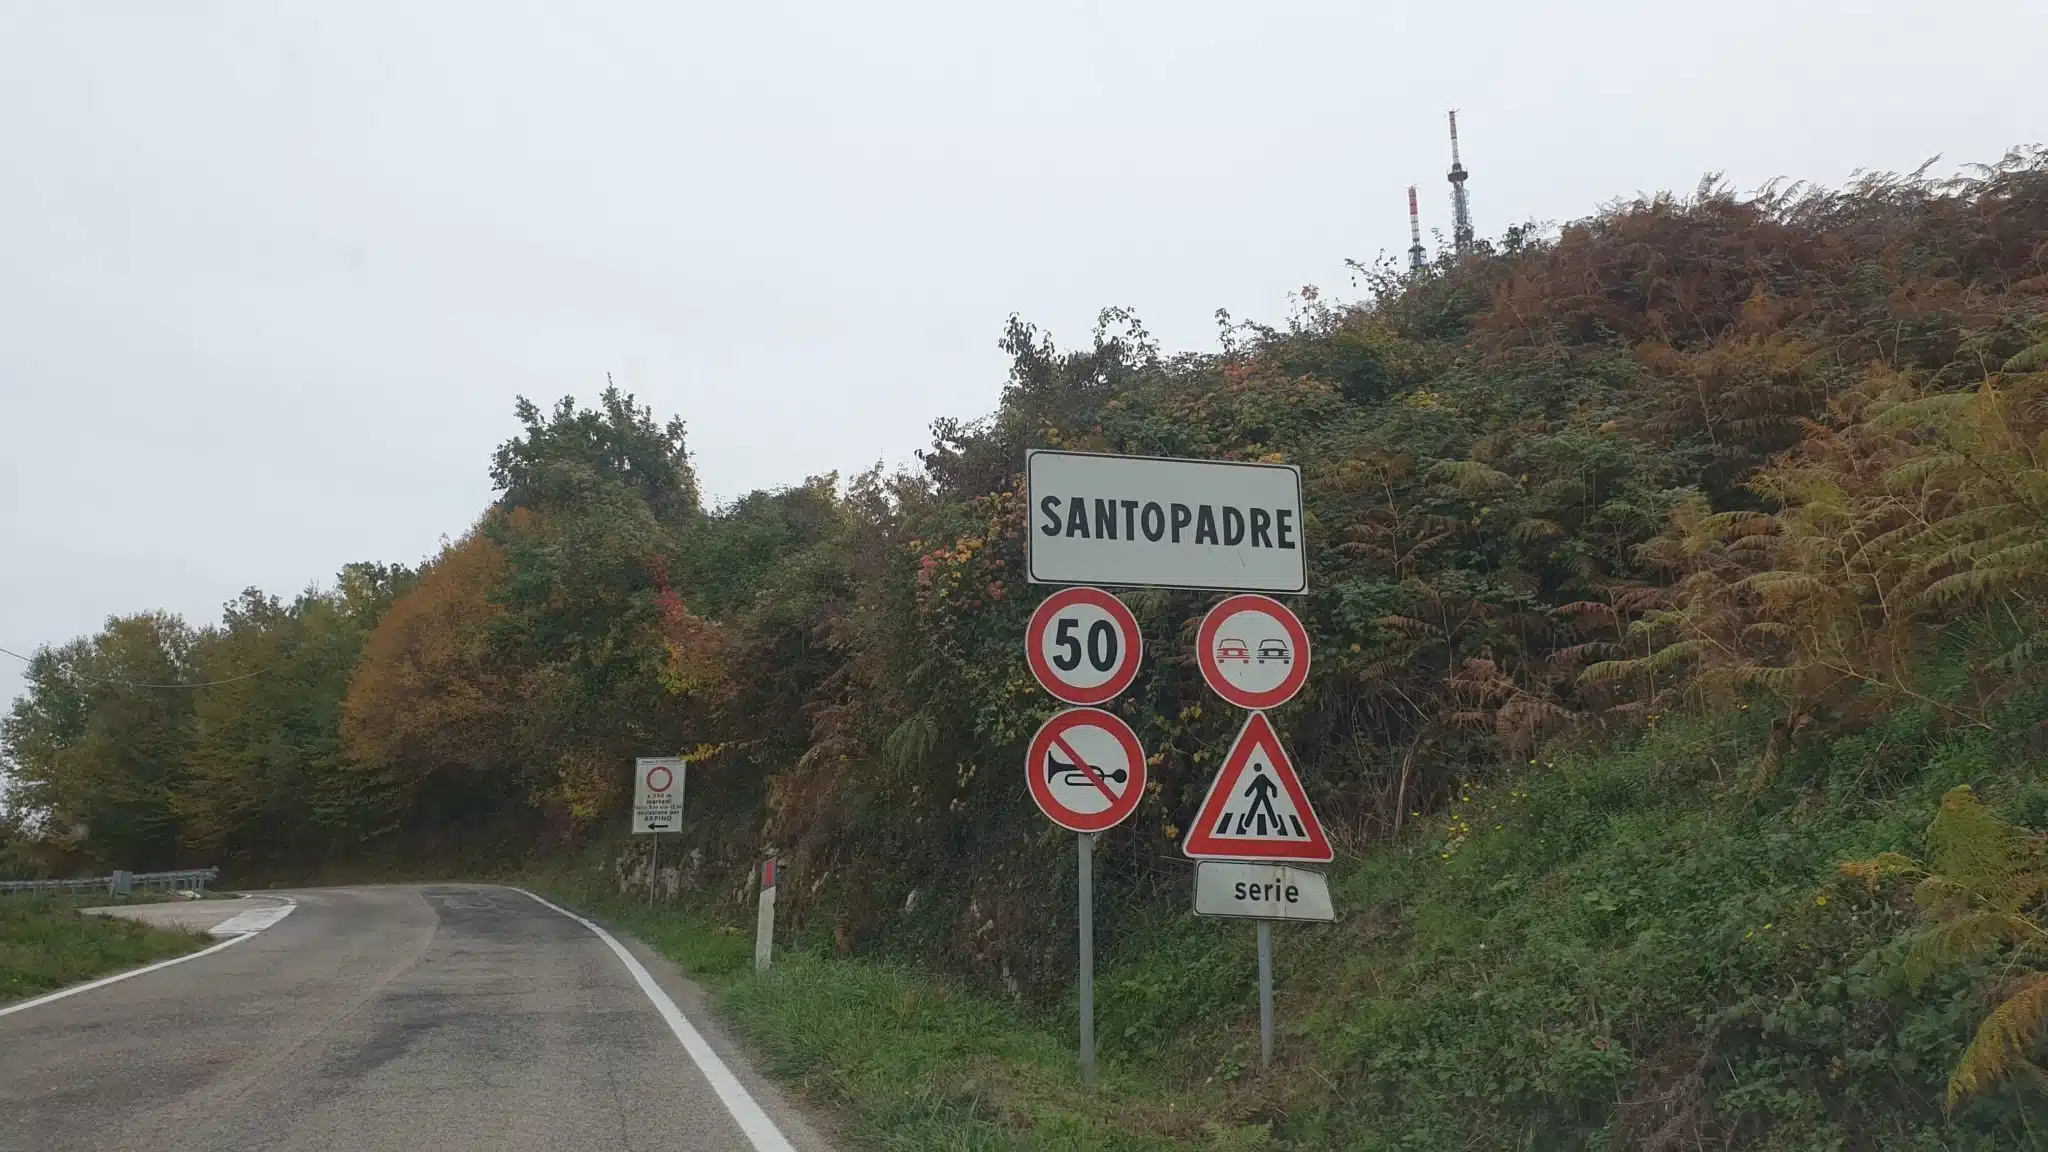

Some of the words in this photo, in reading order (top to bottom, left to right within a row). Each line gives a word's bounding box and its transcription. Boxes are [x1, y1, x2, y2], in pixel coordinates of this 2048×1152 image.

[1040, 495, 1296, 550] SANTOPADRE
[1053, 618, 1117, 672] 50
[1234, 877, 1300, 904] serie
